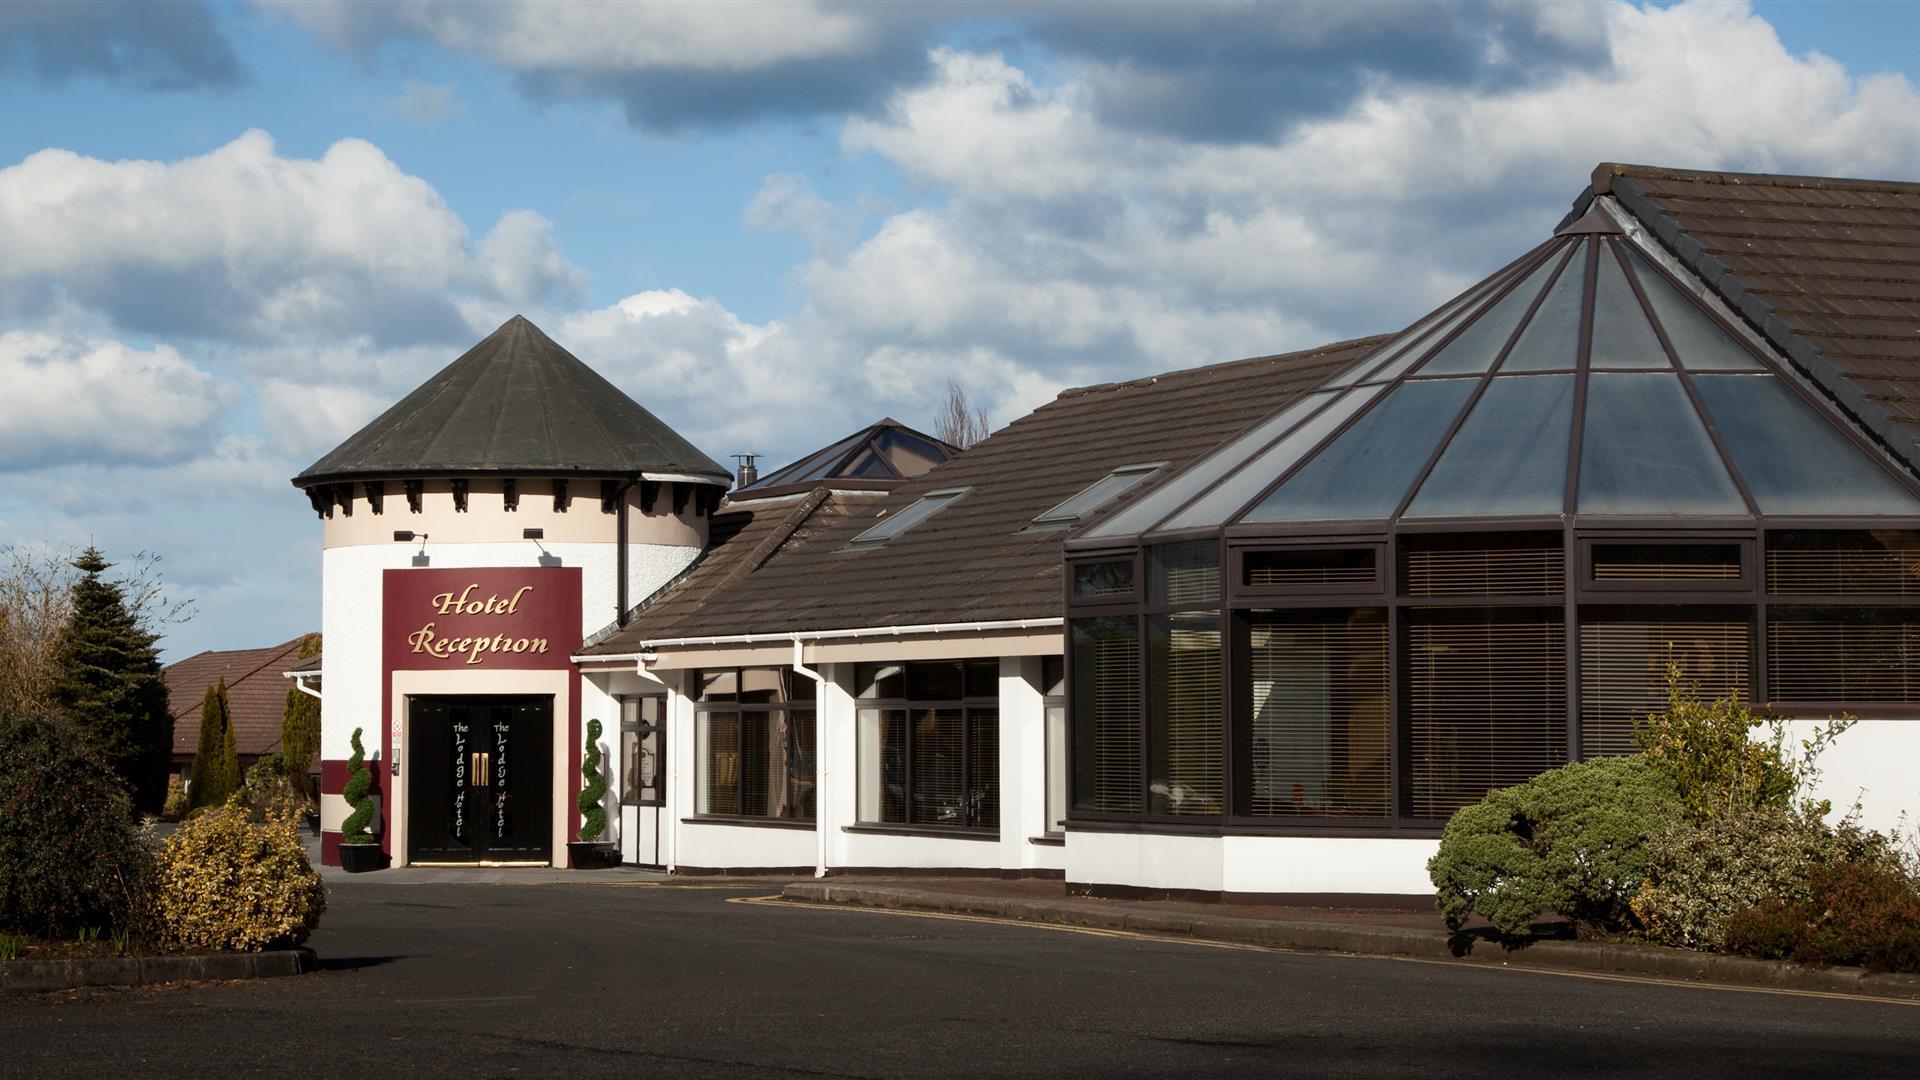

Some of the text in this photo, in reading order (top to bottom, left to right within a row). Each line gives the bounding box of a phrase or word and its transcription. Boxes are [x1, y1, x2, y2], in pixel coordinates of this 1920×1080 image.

[432, 583, 533, 615] Hotel
[408, 622, 549, 664] Reception
[453, 721, 469, 837] The Lodge Hotel
[493, 721, 510, 838] The Lodge Hotel
